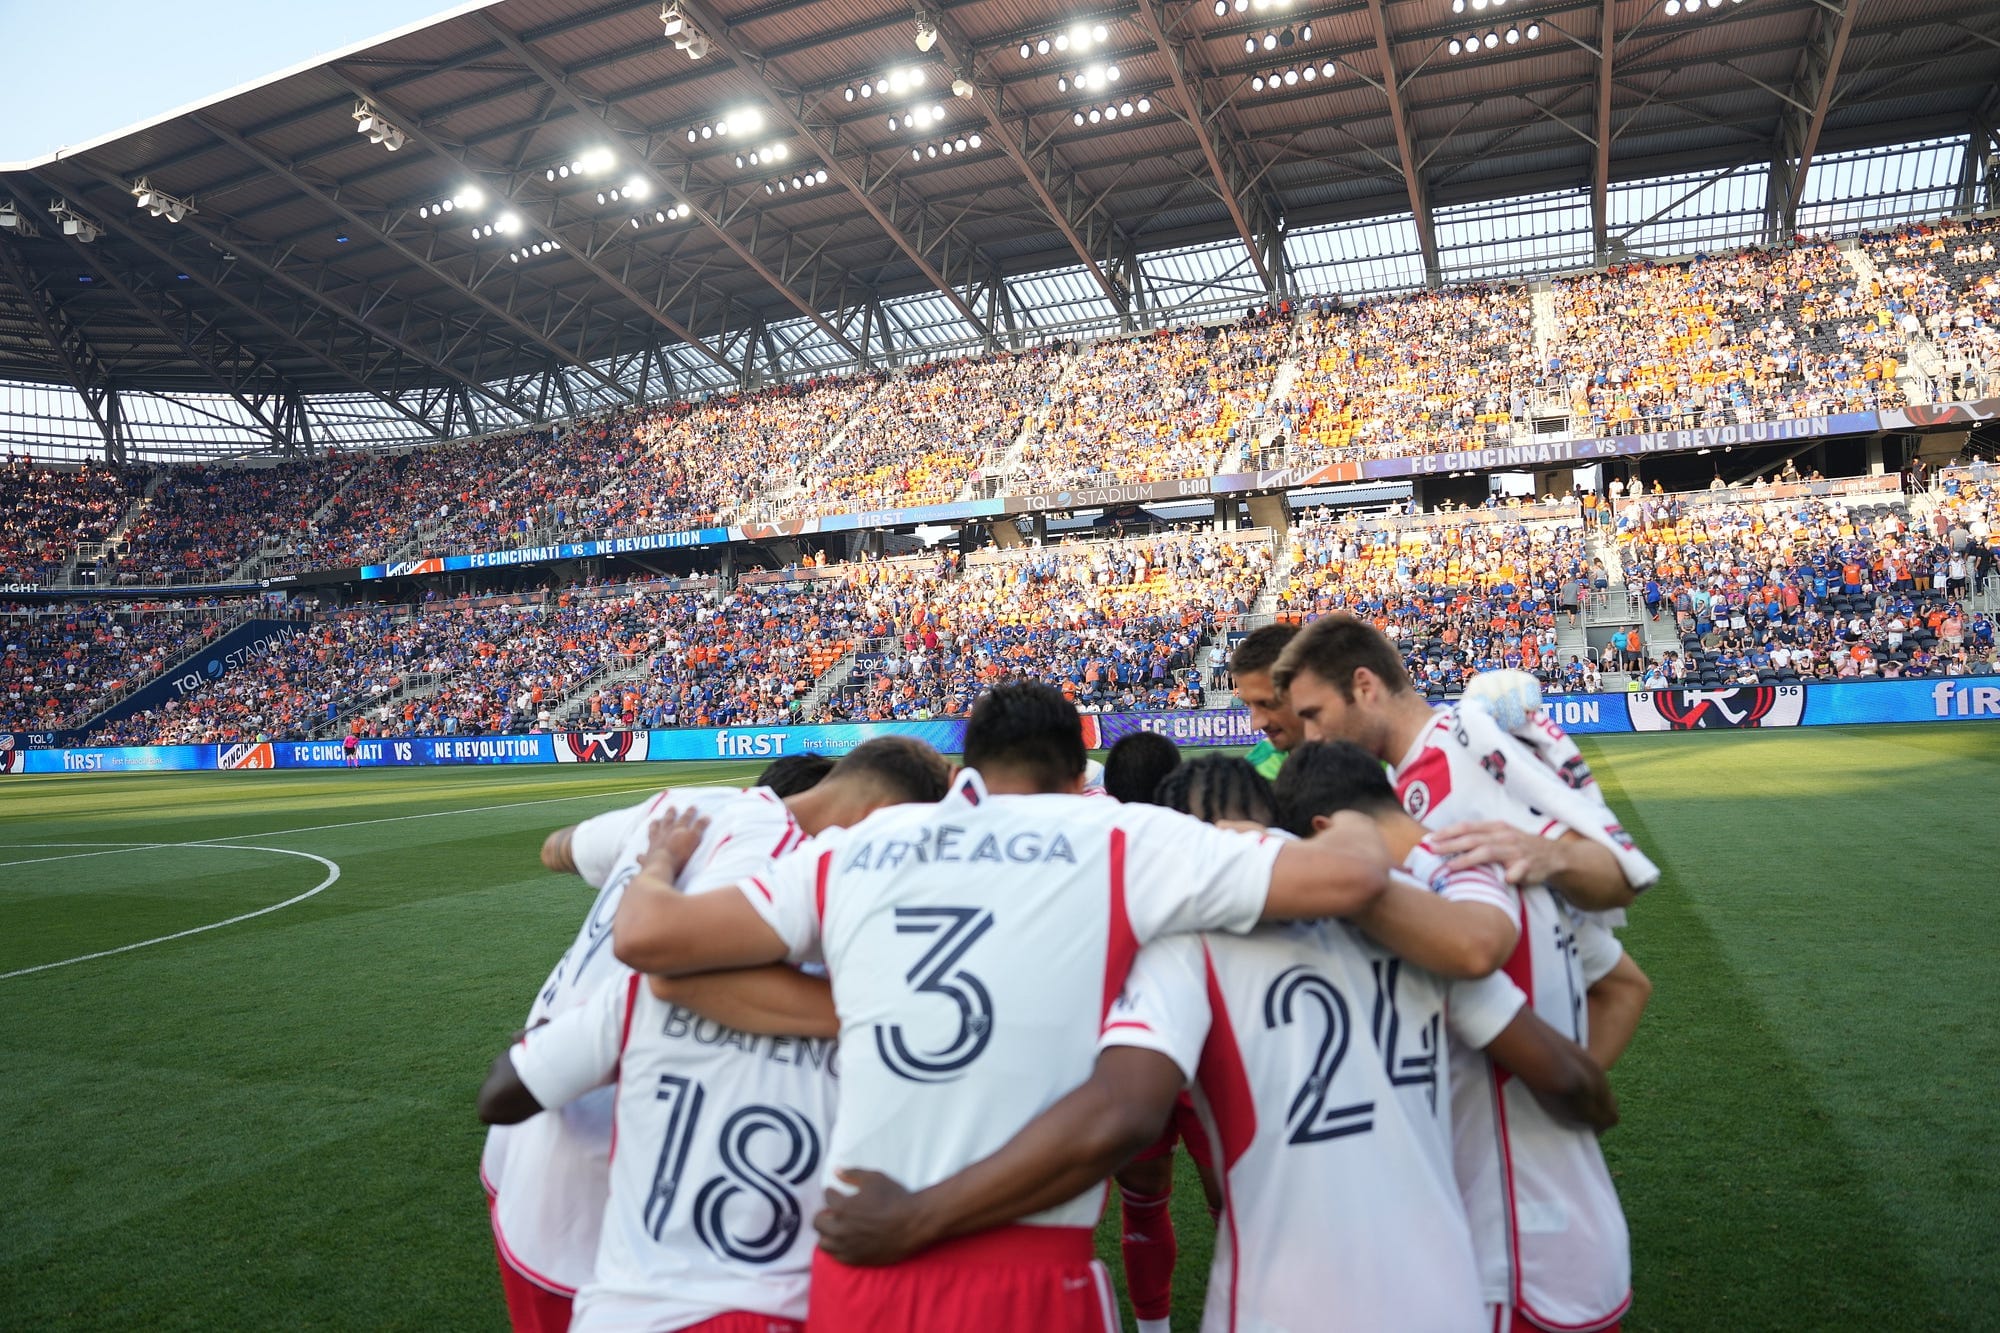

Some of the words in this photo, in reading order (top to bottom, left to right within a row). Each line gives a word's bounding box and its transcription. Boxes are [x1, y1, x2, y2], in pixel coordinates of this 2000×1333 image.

[1411, 457, 1437, 473] FC
[1443, 442, 1572, 470] CINCINNATI
[1595, 438, 1617, 454] VS
[1640, 432, 1669, 451] NE
[1676, 416, 1828, 449] REVOLUTION
[1023, 495, 1056, 511] TQL
[1077, 485, 1153, 506] STADIUM
[1178, 478, 1209, 495] 0:00
[470, 554, 485, 567] FC
[488, 545, 560, 566] CINCINNATI
[572, 544, 584, 556] VS
[596, 540, 613, 554] NE
[616, 530, 700, 552] REVOLUTION
[0, 583, 39, 593] IGHT
[1634, 692, 1649, 703] 19
[1780, 686, 1798, 697] 96
[634, 731, 646, 740] 96
[1140, 718, 1167, 737] FC
[28, 734, 46, 745] TQL
[556, 734, 566, 743] 19
[802, 738, 823, 749] first
[294, 746, 310, 762] FC
[394, 742, 412, 761] VS
[434, 742, 451, 758] NE
[454, 739, 540, 757] REVOLUTION
[874, 907, 995, 1084] 3
[1264, 958, 1440, 1146] 24
[644, 1073, 821, 1265] 18
